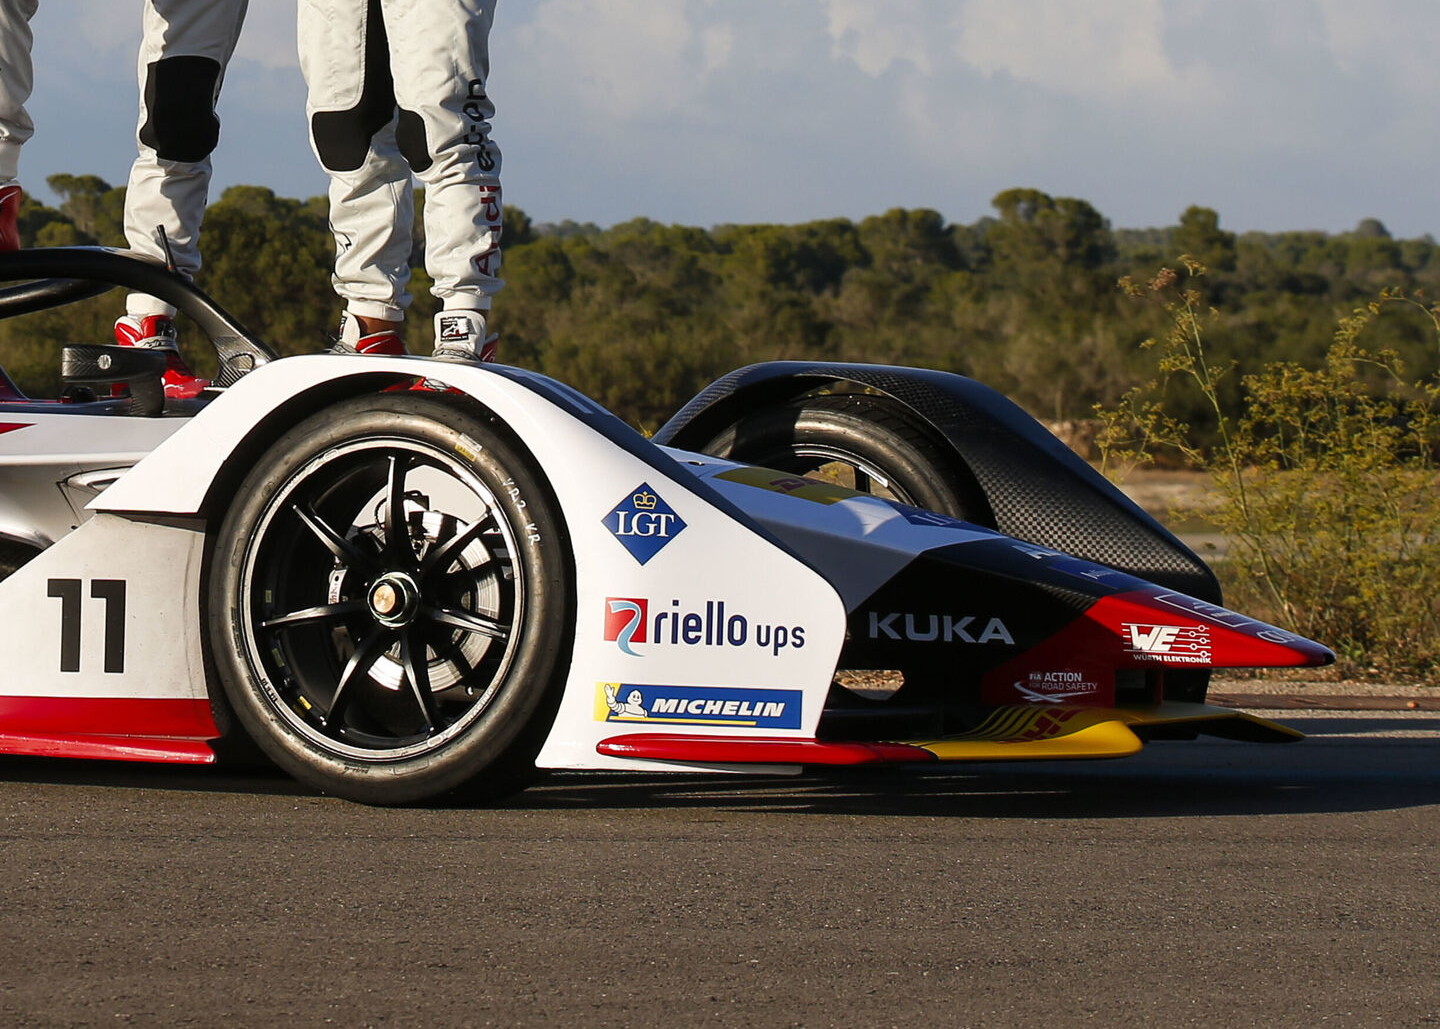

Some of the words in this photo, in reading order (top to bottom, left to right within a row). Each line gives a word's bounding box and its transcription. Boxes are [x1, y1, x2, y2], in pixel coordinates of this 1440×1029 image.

[615, 511, 675, 537] LGT
[47, 578, 127, 674] 11
[654, 599, 748, 647] riello
[757, 624, 805, 656] ups
[869, 611, 1015, 645] KUKA
[1130, 625, 1180, 652] WE
[1163, 655, 1212, 664] ELEKTRONIK
[1042, 682, 1064, 690] ROAD
[1066, 682, 1098, 691] SAFETY
[1044, 672, 1082, 682] ACTION
[651, 698, 786, 718] MICHELIN
